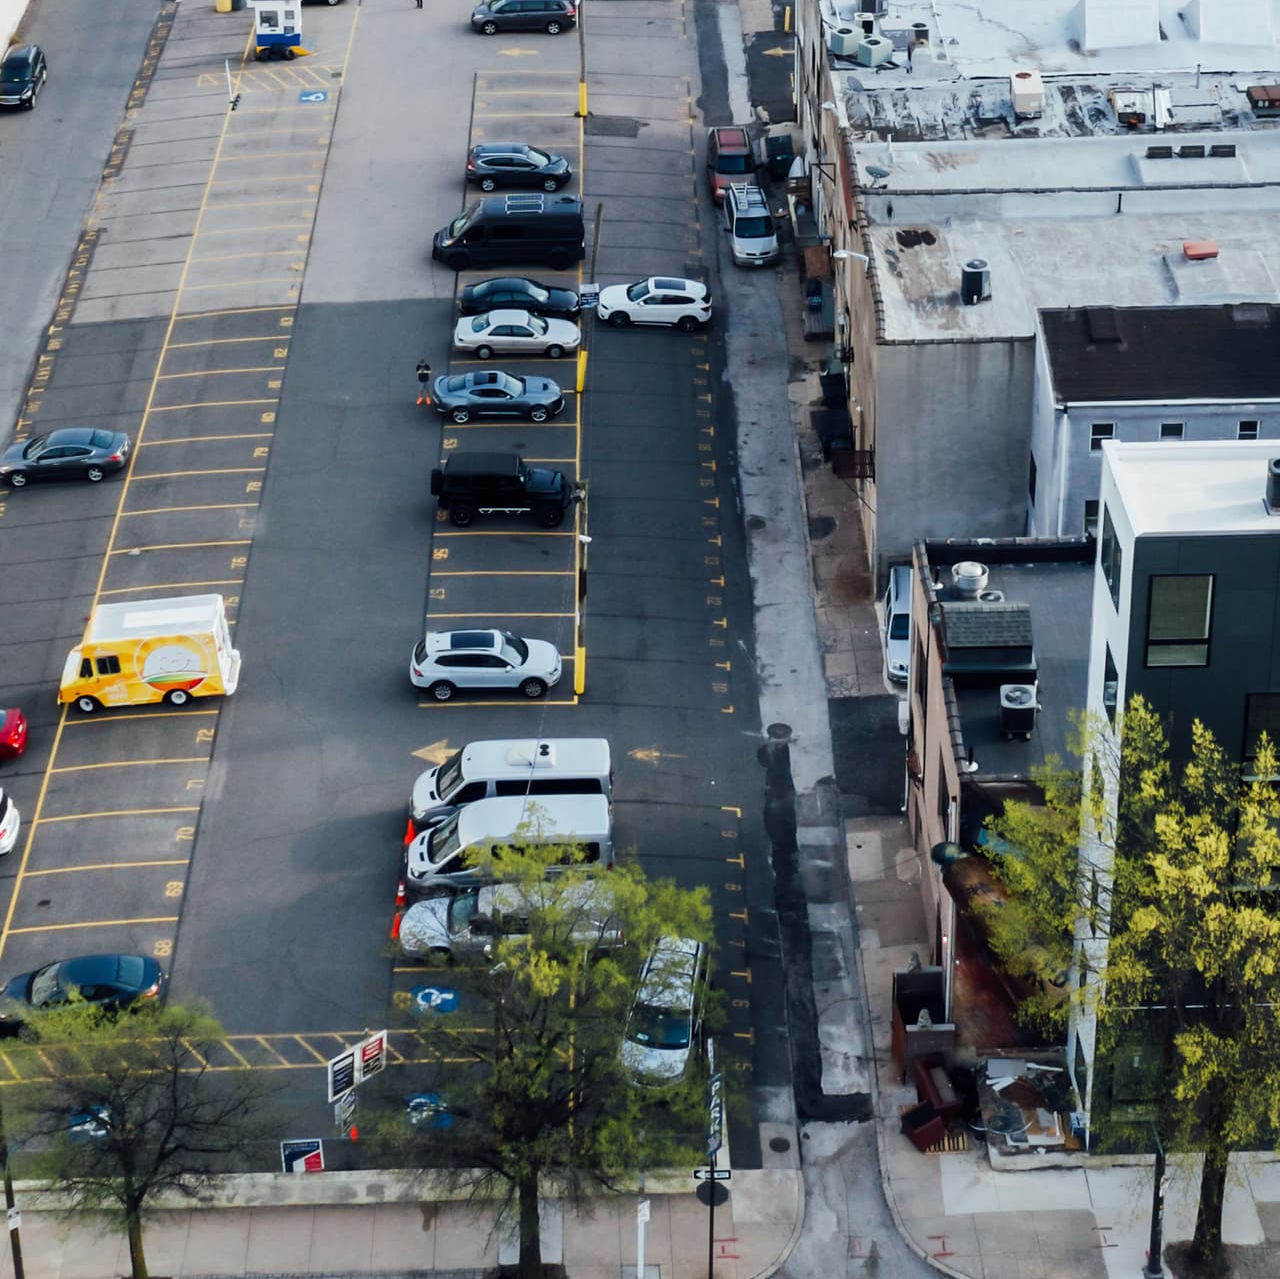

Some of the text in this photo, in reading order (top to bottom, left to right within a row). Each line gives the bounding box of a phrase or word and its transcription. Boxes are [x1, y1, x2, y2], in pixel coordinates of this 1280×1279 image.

[196, 729, 214, 744] 72
[176, 826, 195, 842] 70
[165, 881, 184, 897] 69
[154, 939, 172, 956] 68
[736, 1062, 753, 1071] 5
